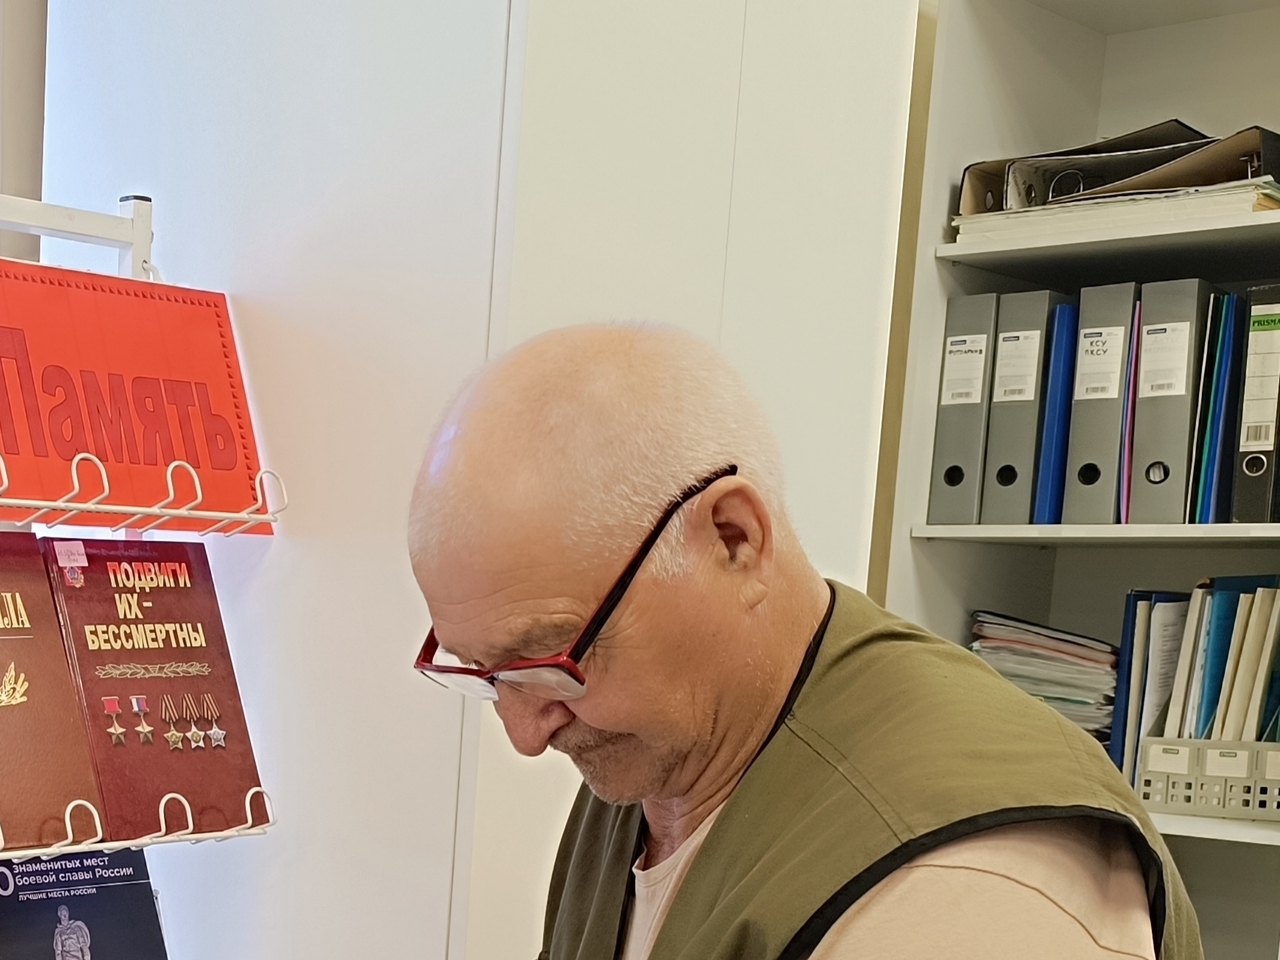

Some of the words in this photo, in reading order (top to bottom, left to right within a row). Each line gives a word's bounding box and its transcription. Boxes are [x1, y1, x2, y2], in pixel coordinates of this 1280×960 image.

[1089, 339, 1107, 347] КСУ
[1084, 348, 1108, 356] ПКСУ
[109, 562, 191, 588] ПОДВИГИ
[84, 624, 206, 650] БЕССМЕРТНЫ
[13, 860, 81, 874] знаменитых
[83, 857, 109, 868] мест
[15, 871, 56, 886] боевой
[59, 870, 93, 882] славы
[95, 866, 133, 878] России
[18, 891, 47, 901] ЛУЧШИЕ
[49, 890, 69, 899] МЕСТА
[71, 887, 97, 897] РОССИИ
